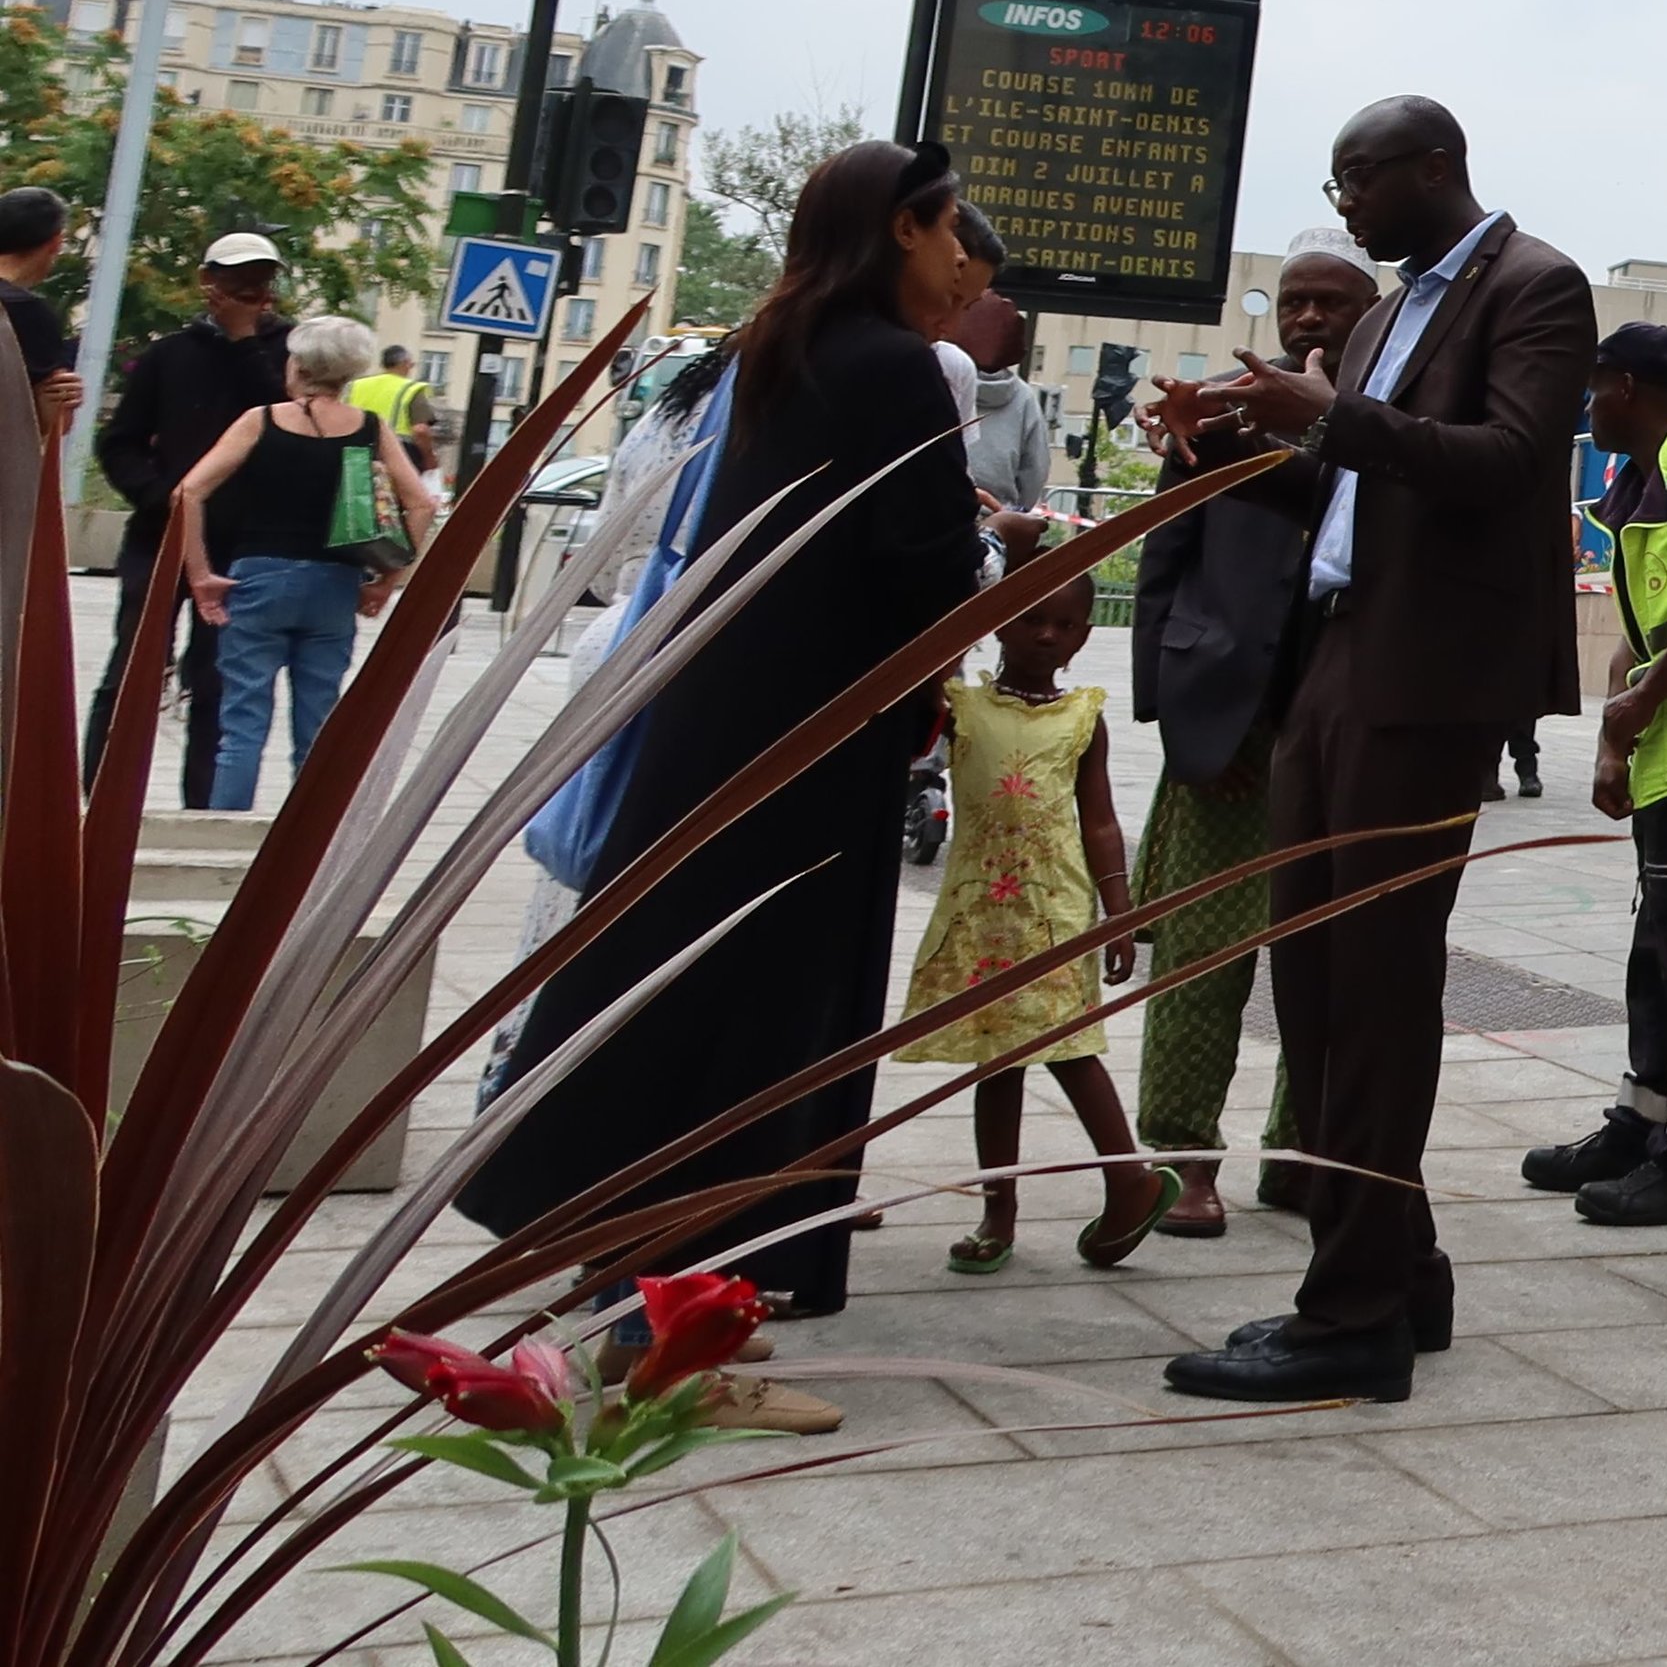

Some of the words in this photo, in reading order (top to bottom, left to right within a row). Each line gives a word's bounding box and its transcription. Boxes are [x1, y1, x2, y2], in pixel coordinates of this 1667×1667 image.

[1003, 3, 1084, 31] INFOS
[1141, 21, 1217, 44] 12:06
[1049, 47, 1128, 72] SPORT
[982, 69, 1077, 96] COURSE
[1092, 80, 1154, 103] 10KM
[1170, 88, 1200, 107] DE
[946, 96, 1211, 136] L'ILE-SAINT-DENIS
[942, 124, 975, 144] ET
[990, 128, 1084, 154] COURSE
[1101, 140, 1209, 164] ENFANTS
[970, 155, 1017, 177] DIM
[1033, 161, 1048, 179] 2
[1065, 167, 1175, 190] JUILLET
[1190, 174, 1206, 193] A
[966, 183, 1076, 211] MARQUES
[1092, 194, 1186, 220] AVENUE
[986, 215, 1136, 245] CRIPTIONS
[1153, 229, 1199, 250] SUR
[1008, 247, 1196, 279] -SAINT-DENIS
